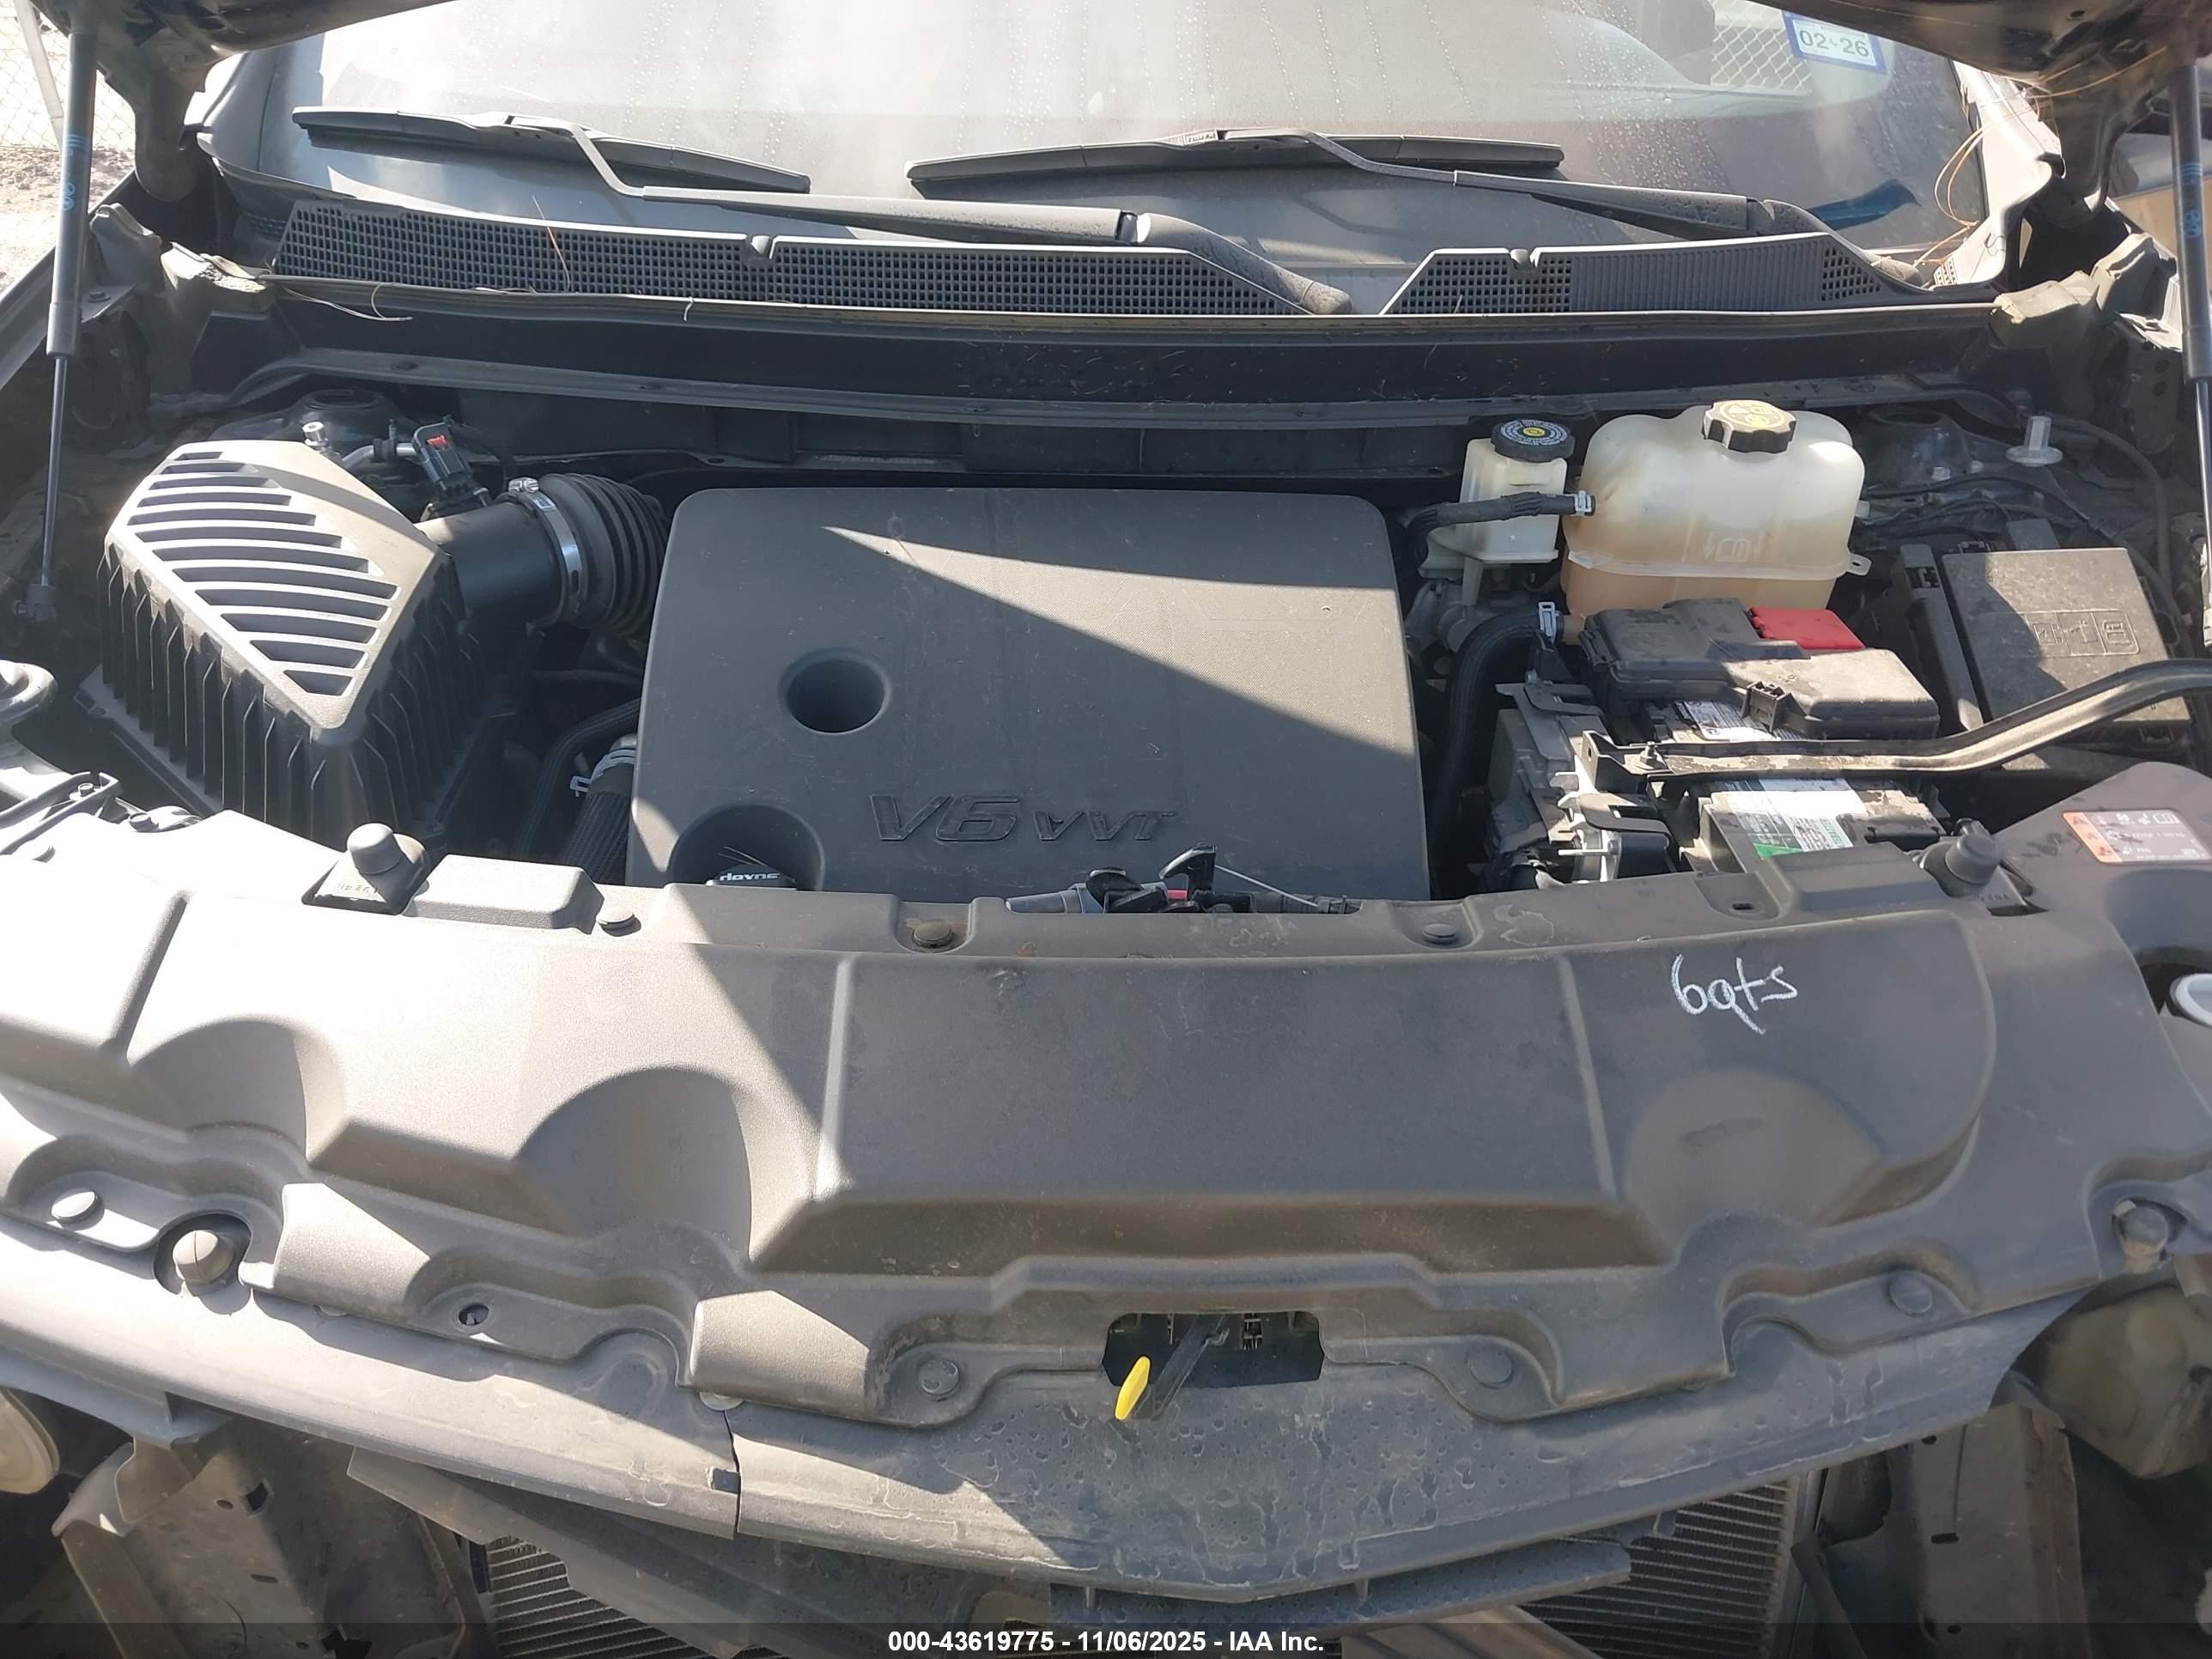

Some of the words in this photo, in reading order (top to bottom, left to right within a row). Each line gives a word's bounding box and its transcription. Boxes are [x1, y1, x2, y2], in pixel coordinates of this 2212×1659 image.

[870, 793, 1019, 842] V6
[1032, 809, 1176, 842] VVT
[1670, 953, 1799, 1035] 6qts
